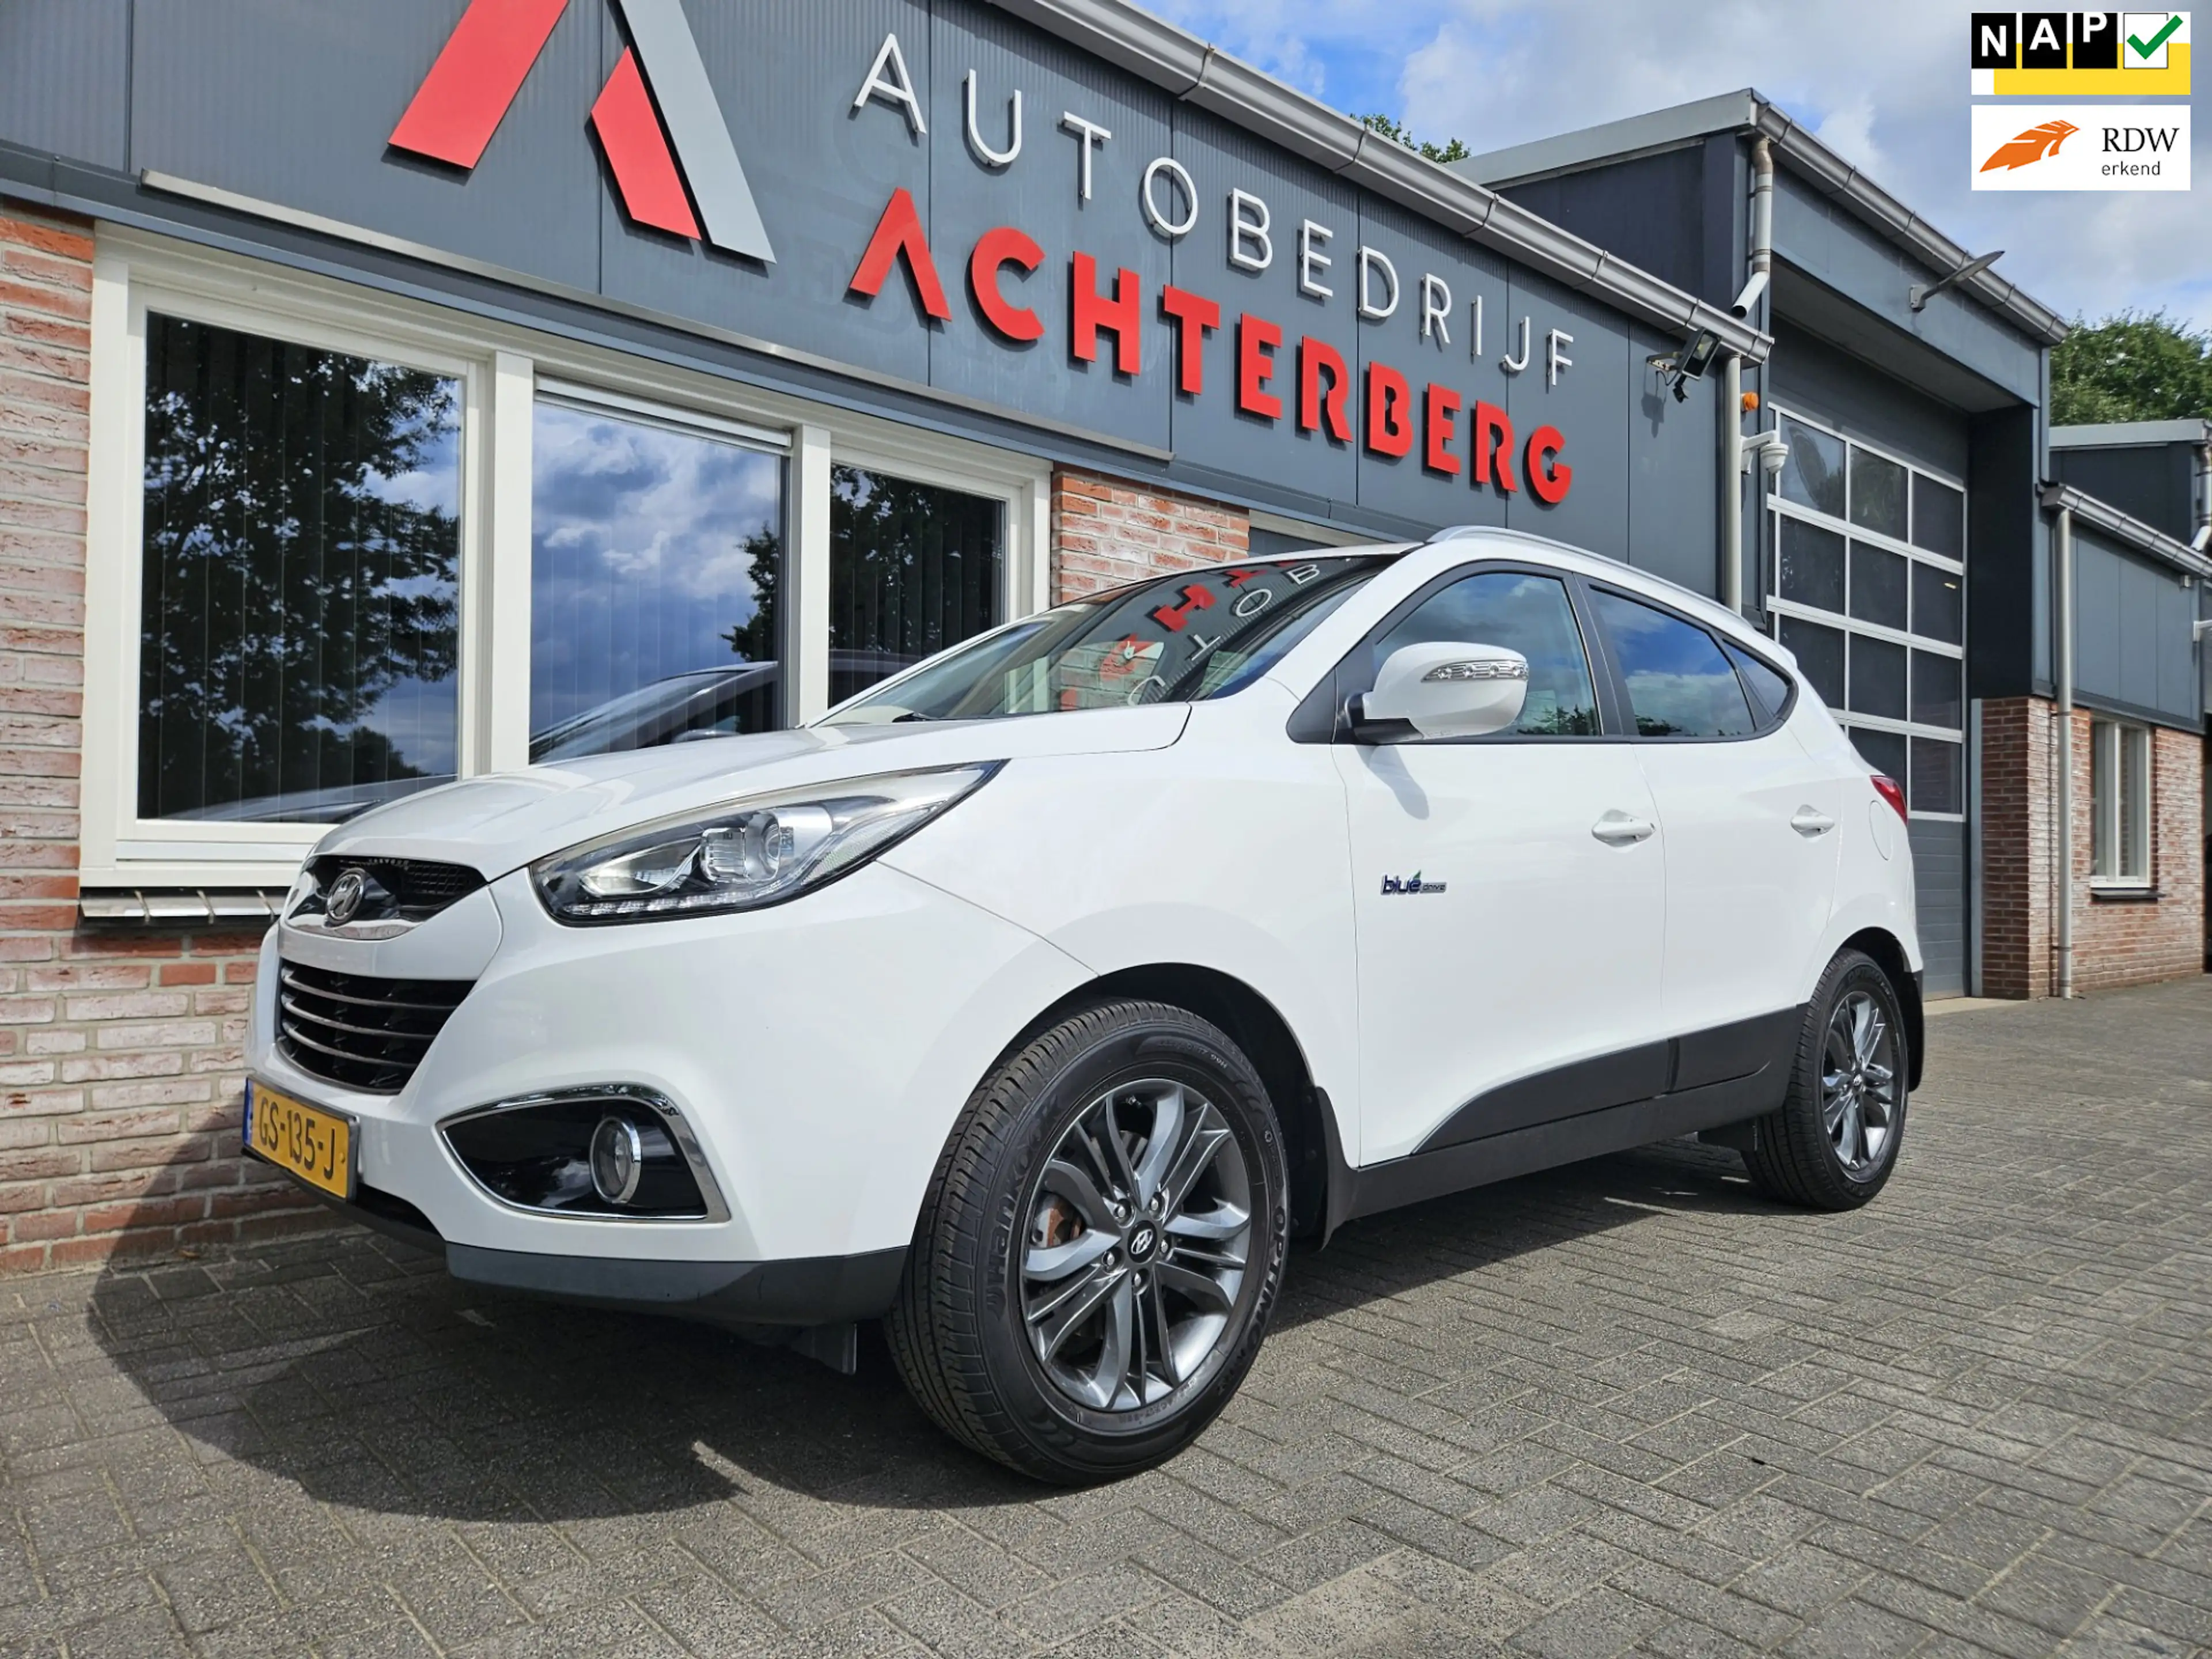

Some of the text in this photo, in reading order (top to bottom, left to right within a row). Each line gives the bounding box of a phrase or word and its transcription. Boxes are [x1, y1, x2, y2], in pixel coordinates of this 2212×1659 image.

[854, 32, 1574, 386] AUTOBEDRIJF
[848, 186, 1573, 504] ACHTERBERG
[1381, 873, 1422, 894] blue
[259, 1096, 336, 1180] GS-135-J
[1246, 1205, 1286, 1351] OPTIMO
